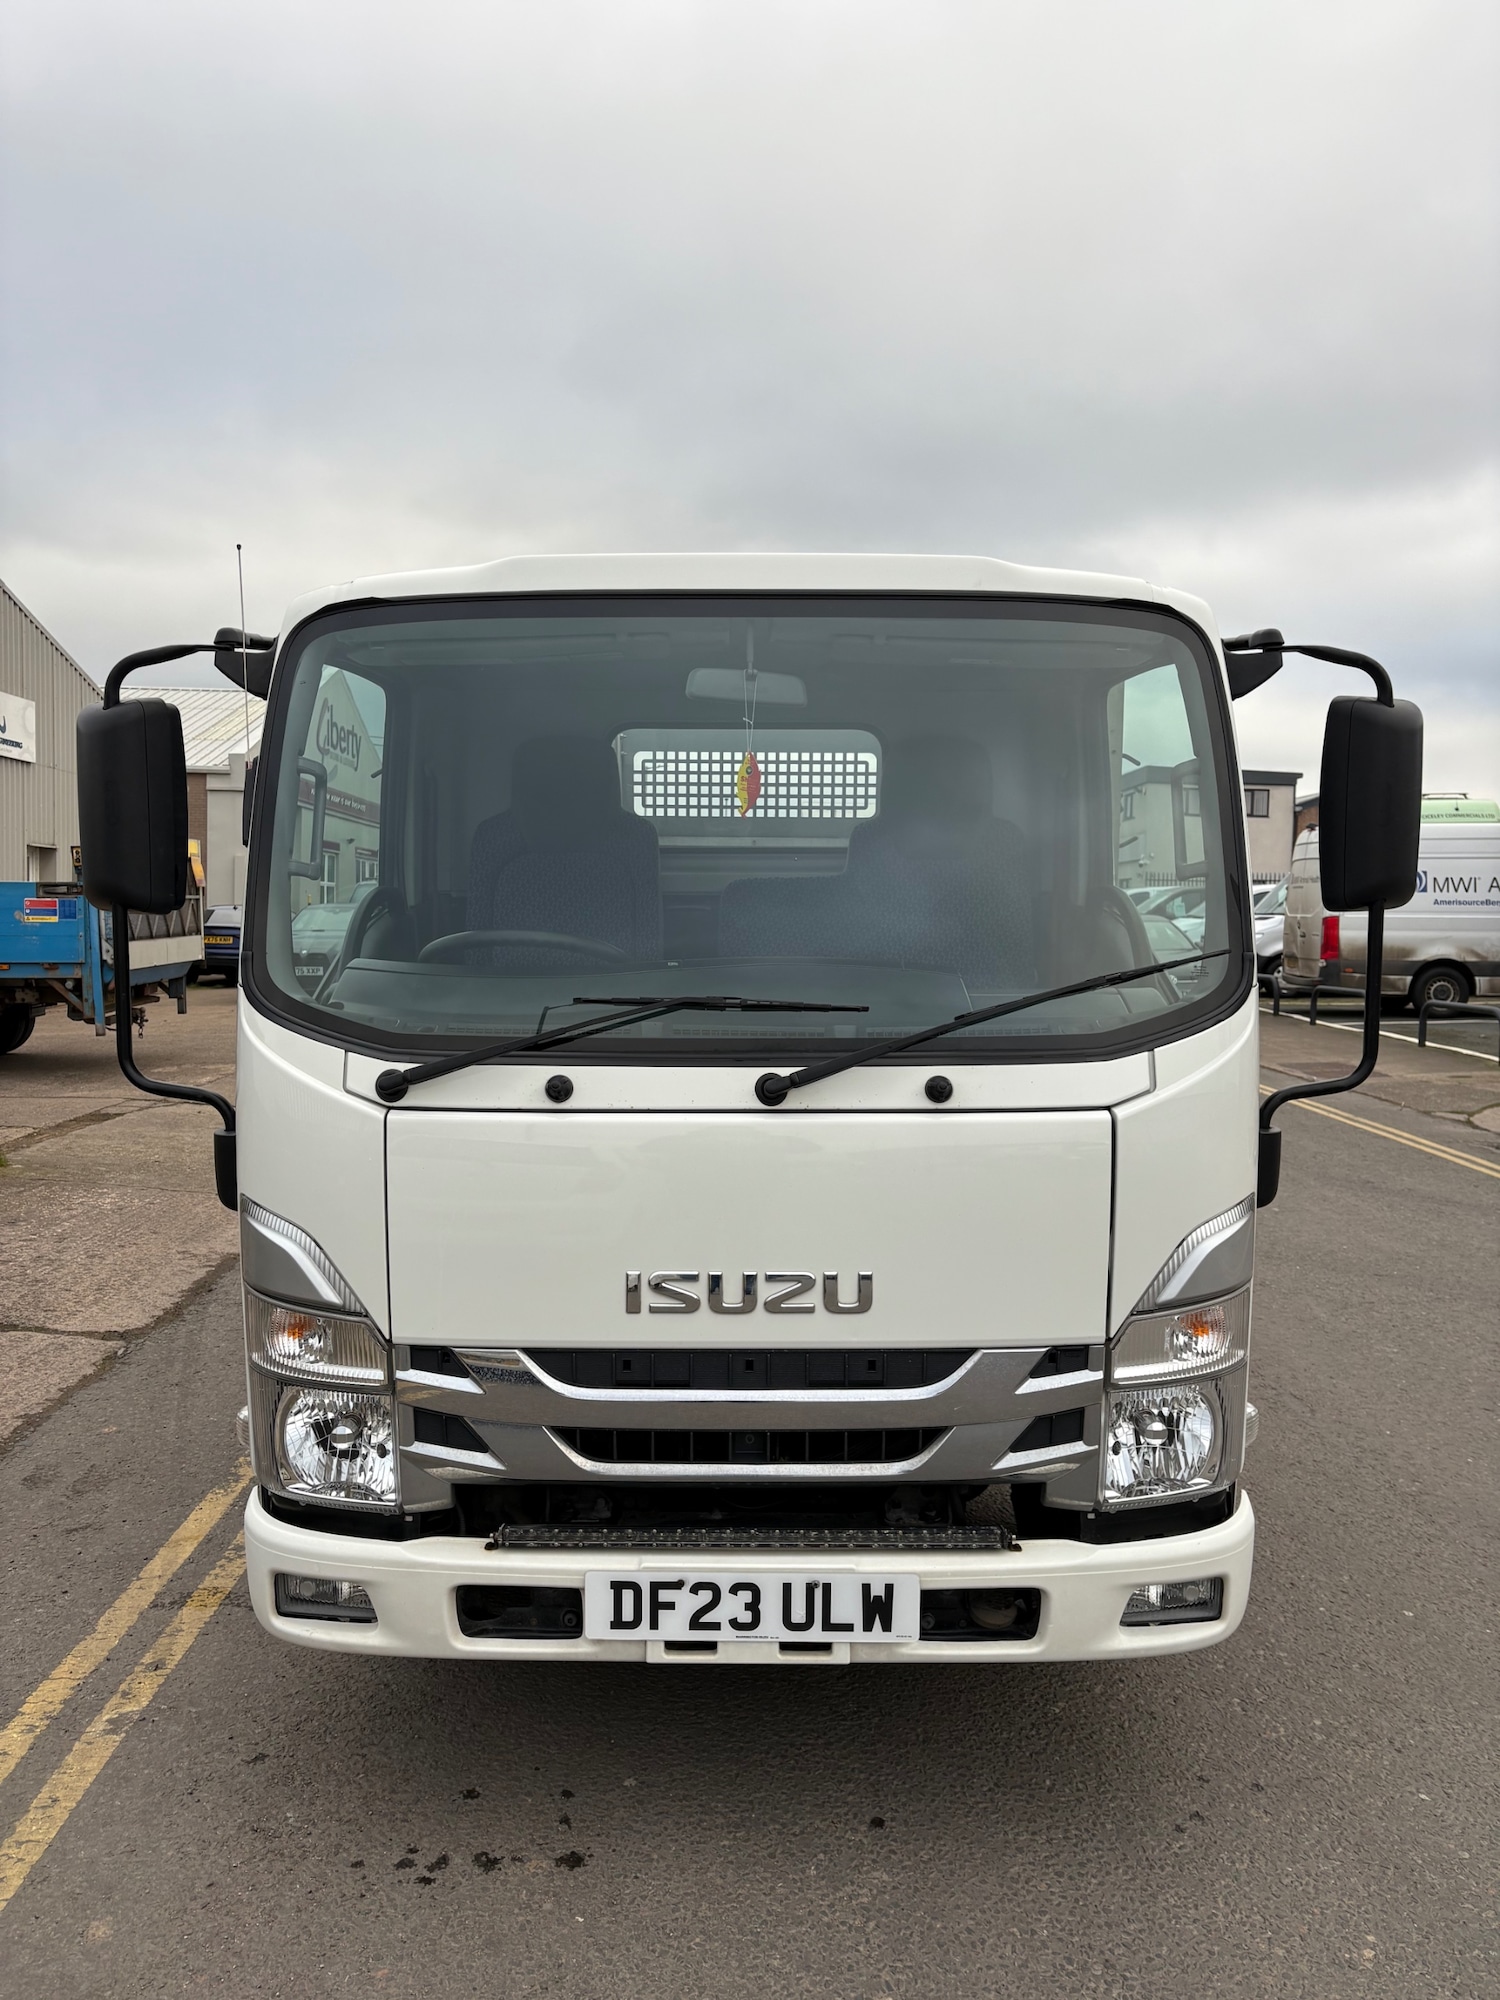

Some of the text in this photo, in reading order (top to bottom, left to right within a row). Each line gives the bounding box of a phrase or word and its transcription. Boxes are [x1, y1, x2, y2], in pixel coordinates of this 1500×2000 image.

[625, 1270, 874, 1314] ISUZU
[609, 1580, 895, 1633] DF23 ULW
